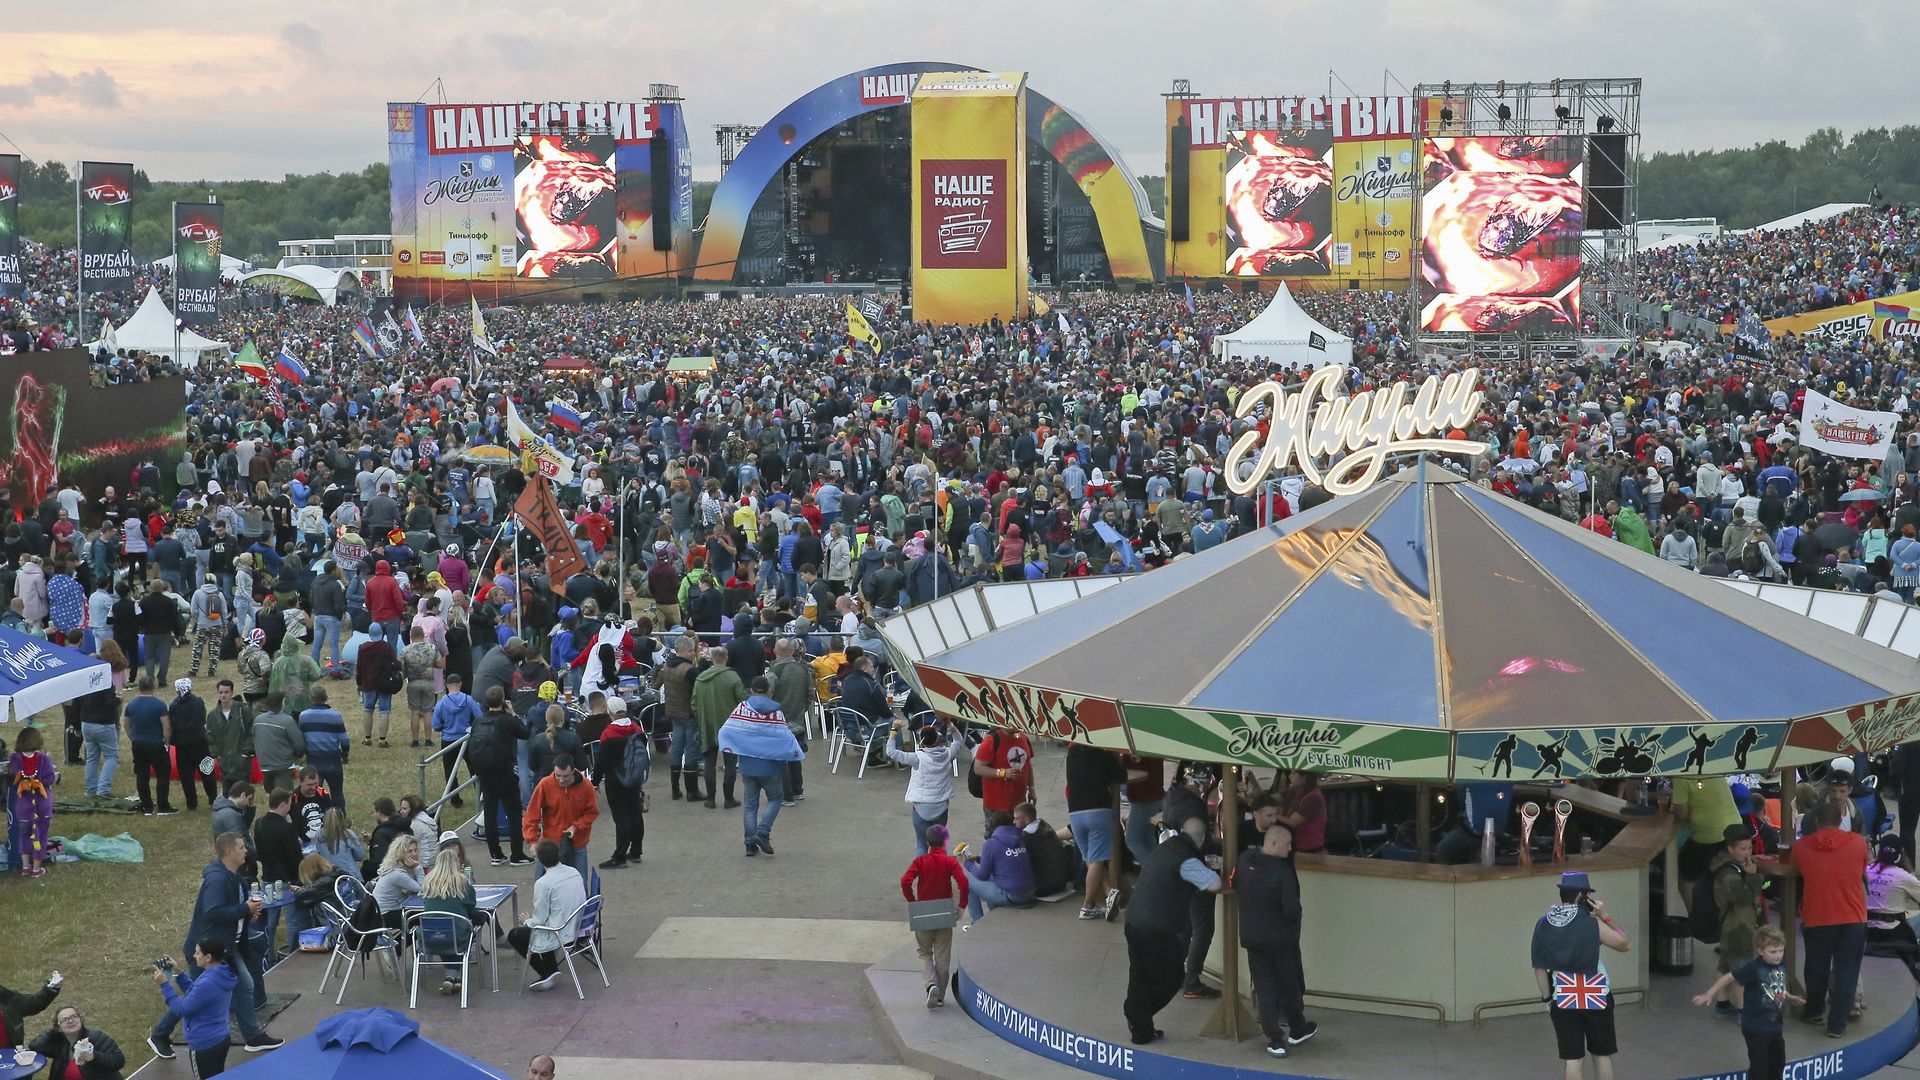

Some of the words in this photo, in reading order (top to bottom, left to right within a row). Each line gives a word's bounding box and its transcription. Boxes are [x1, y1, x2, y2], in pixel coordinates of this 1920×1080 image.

[433, 103, 652, 150] НАШЕСТВИЕ
[424, 174, 502, 206] Жигули
[934, 176, 994, 195] НАШЕ
[934, 197, 981, 208] РАДИО
[449, 232, 488, 240] Тинькофф
[1364, 229, 1406, 237] Тинькофф
[84, 250, 130, 268] ВРУБАЙ
[83, 268, 130, 279] ФЕСТИВАЛЬ
[178, 287, 217, 302] ВРУБАЙ
[178, 302, 216, 313] ФЕСТИВАЛЬ
[1224, 364, 1488, 496] Жигули
[1227, 724, 1341, 756] Жигули
[1307, 752, 1349, 768] EVERY
[1353, 755, 1393, 771] NIGHT
[976, 988, 1135, 1072] #ЖИГУЛИНАШЕСТВИЕ
